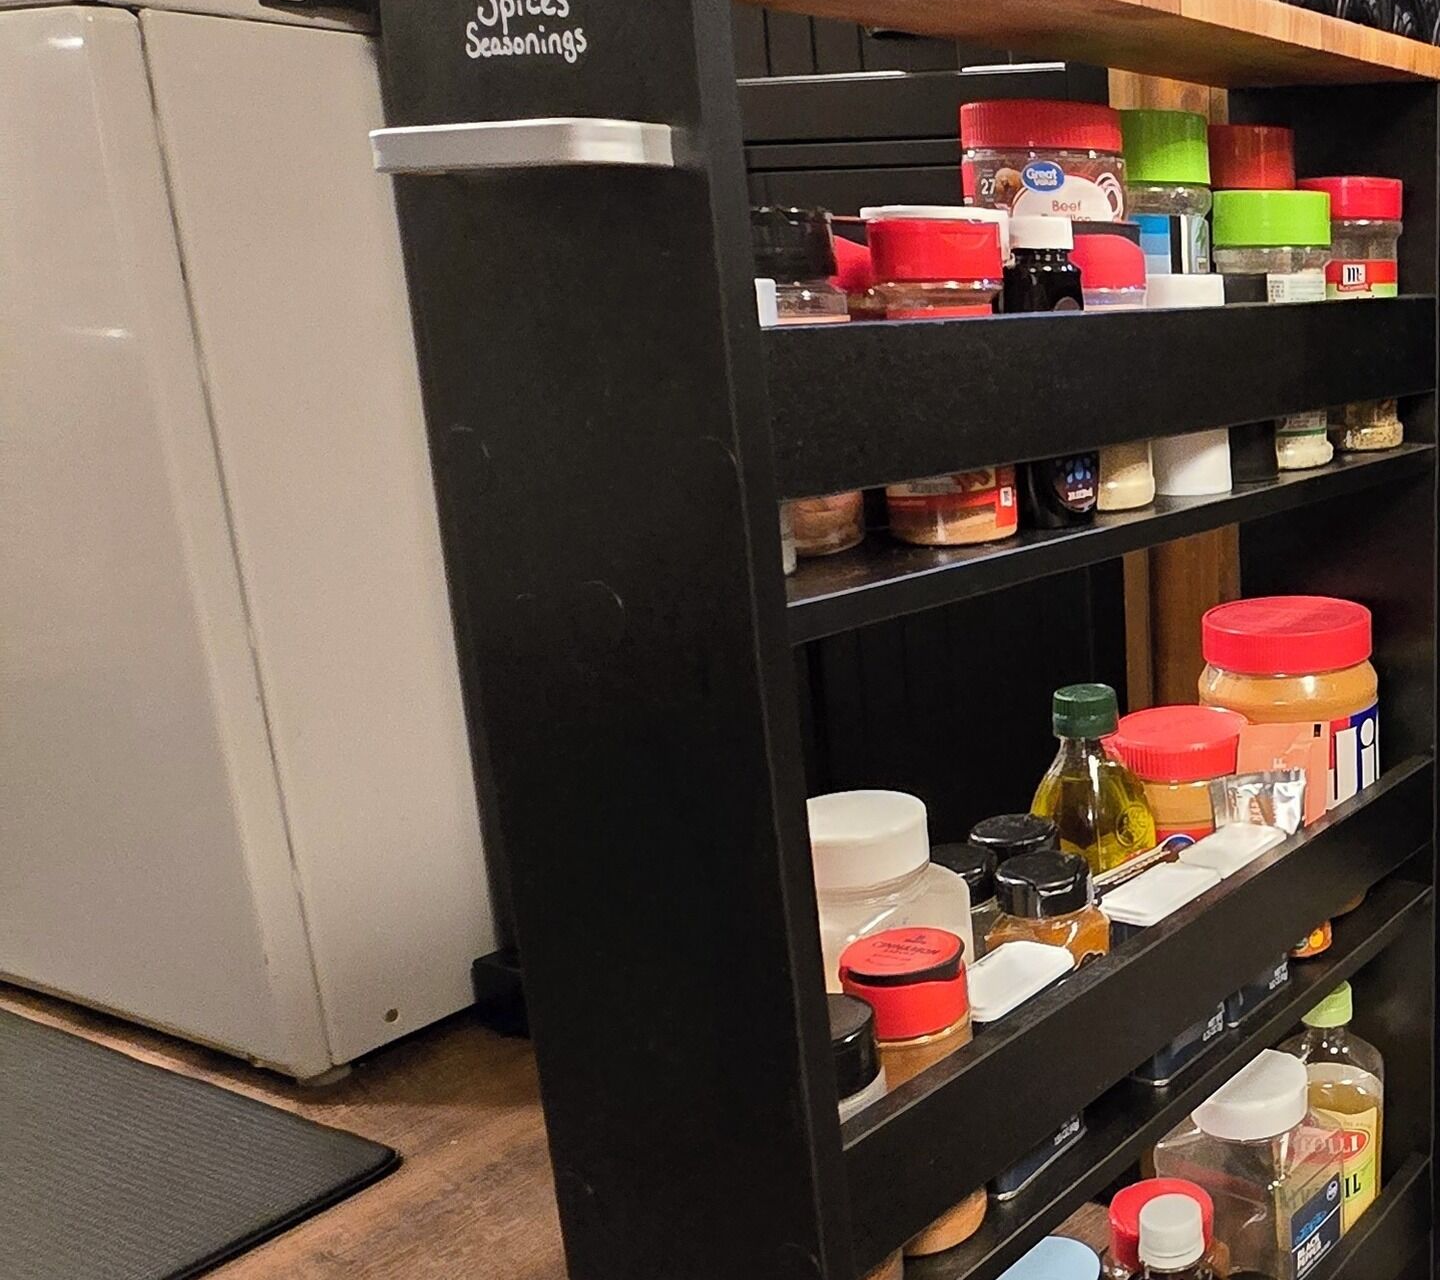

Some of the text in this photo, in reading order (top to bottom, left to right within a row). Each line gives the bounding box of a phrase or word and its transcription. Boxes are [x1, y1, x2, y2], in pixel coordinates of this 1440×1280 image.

[465, 21, 587, 64] Seasonings
[1026, 168, 1058, 181] Great
[1051, 200, 1081, 212] Beef
[1327, 718, 1379, 810] Ji
